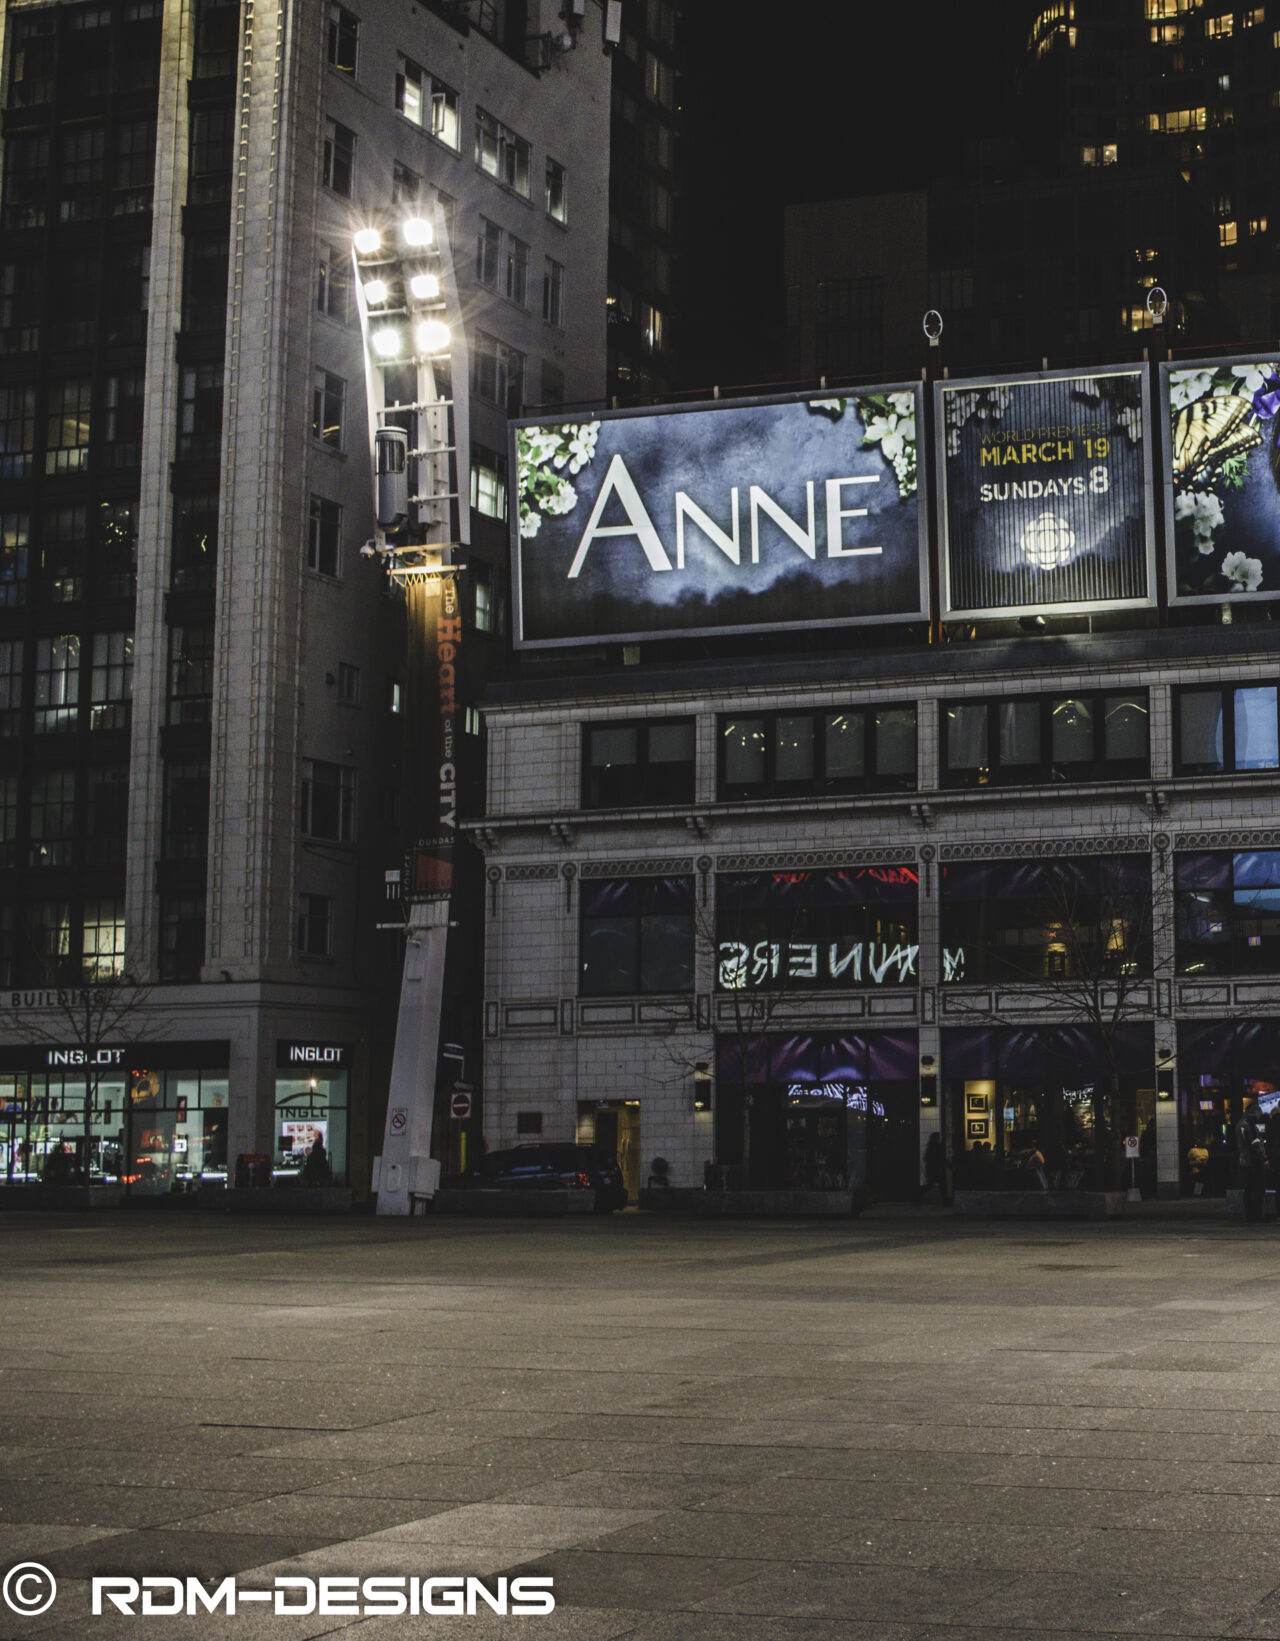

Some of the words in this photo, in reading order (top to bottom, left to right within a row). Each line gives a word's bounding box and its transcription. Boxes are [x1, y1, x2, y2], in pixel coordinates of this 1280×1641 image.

[979, 428, 1035, 445] WORLD
[1038, 423, 1109, 441] PREMIERE
[979, 439, 1075, 468] MARCH
[1082, 437, 1111, 459] 19
[979, 476, 1086, 503] SUNDAYS
[1089, 465, 1111, 494] 8
[567, 453, 883, 579] ANNE
[445, 587, 457, 615] The
[437, 615, 462, 714] Heart
[444, 734, 454, 758] the
[439, 762, 456, 829] CITY
[418, 836, 455, 848] DUNDAS
[11, 989, 105, 1007] BUILDING
[289, 1045, 344, 1063] INGLOT
